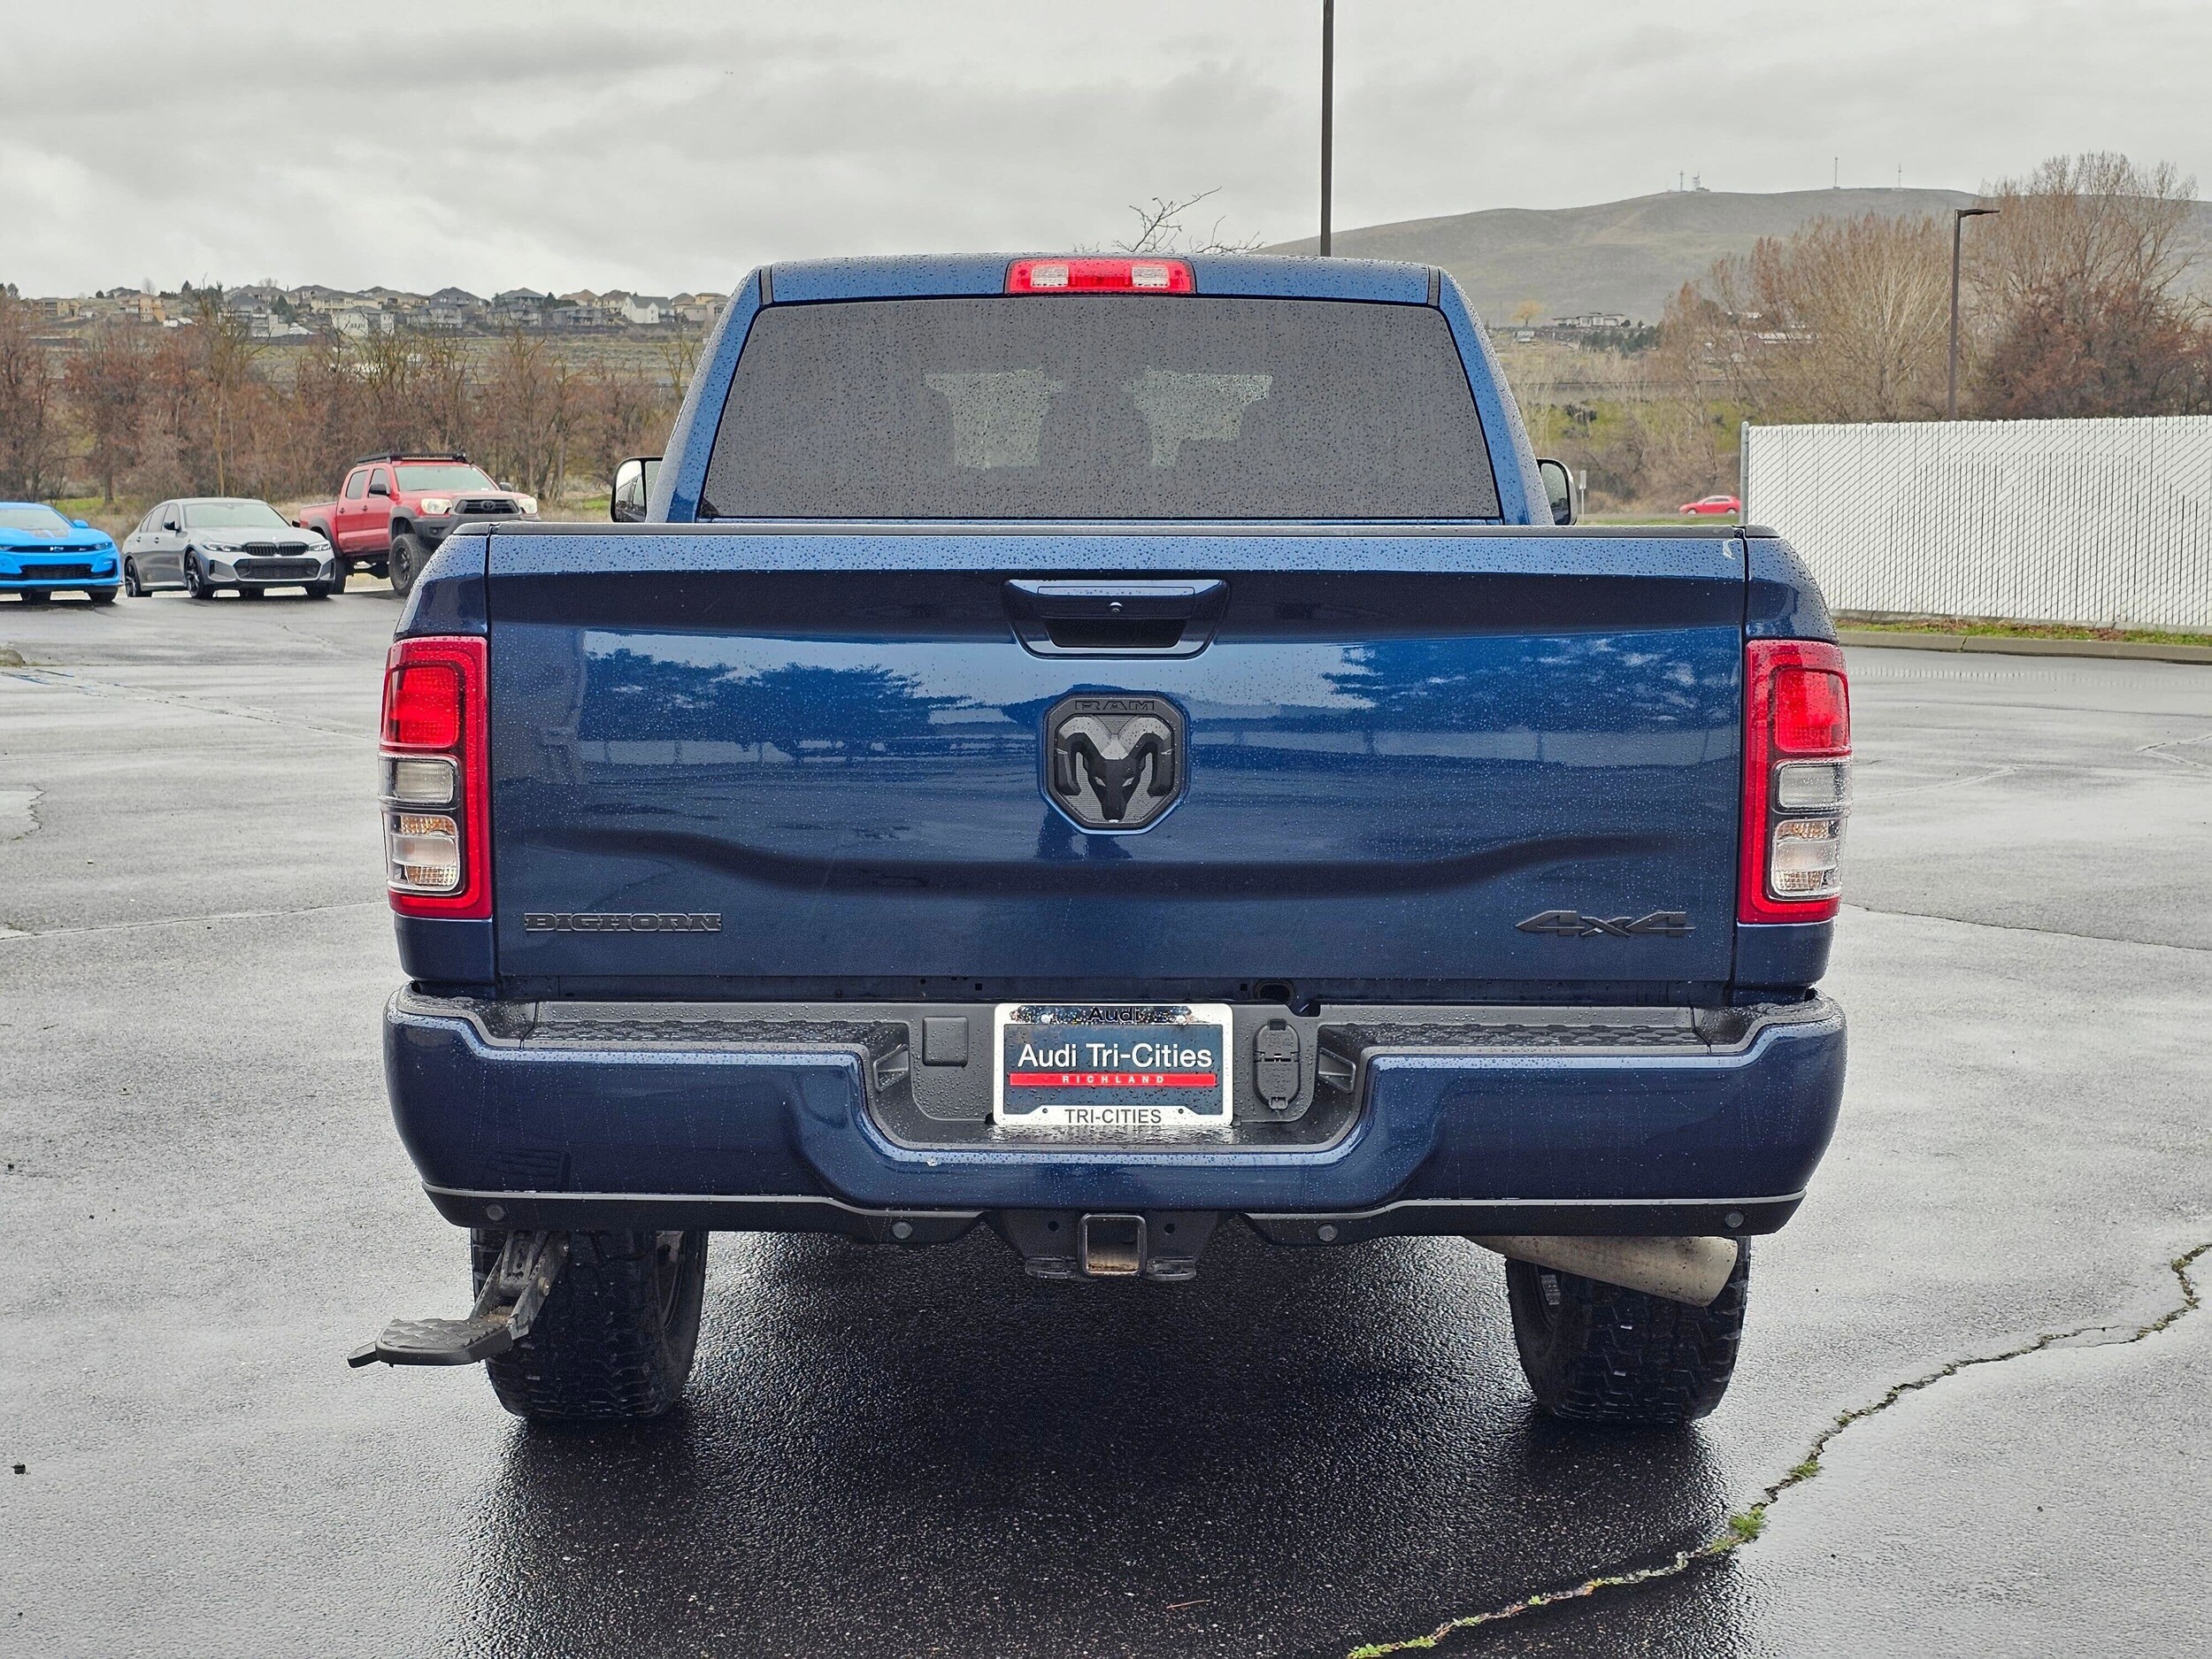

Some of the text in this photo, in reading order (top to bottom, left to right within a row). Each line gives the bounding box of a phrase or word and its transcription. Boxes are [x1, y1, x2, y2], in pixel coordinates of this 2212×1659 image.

[1074, 700, 1155, 710] RAM
[524, 912, 722, 932] BIGHORN
[1087, 1006, 1140, 1022] Audi
[1018, 1042, 1212, 1067] Audi Tri-Cities
[1062, 1075, 1164, 1084] RICHLAND
[1064, 1109, 1162, 1124] TRI-CITIES
